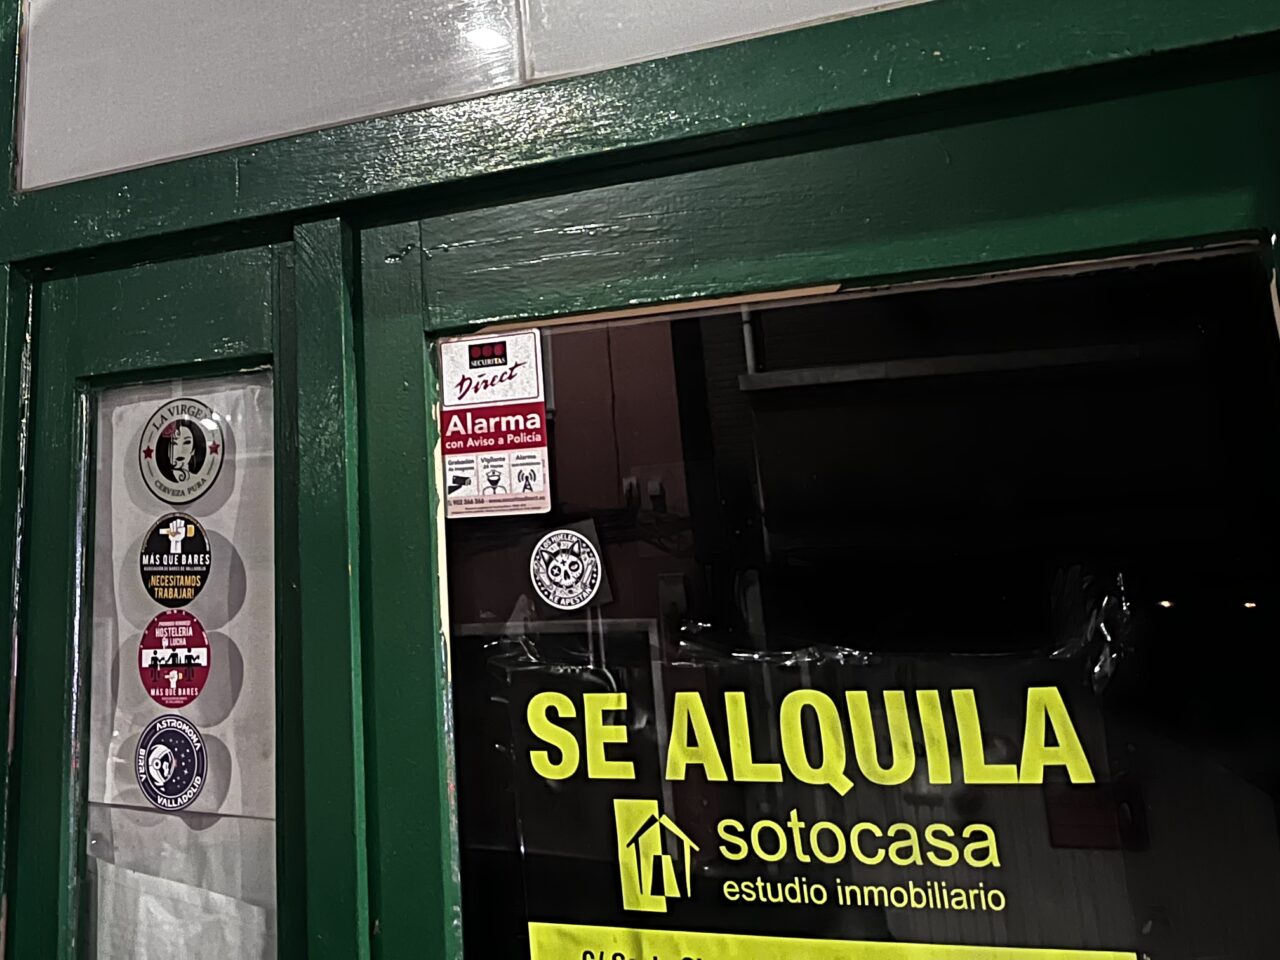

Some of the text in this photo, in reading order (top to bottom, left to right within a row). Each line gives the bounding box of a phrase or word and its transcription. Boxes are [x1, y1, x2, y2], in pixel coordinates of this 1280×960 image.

[470, 357, 506, 367] SECURITAS
[454, 361, 527, 400] Direct
[152, 414, 169, 431] LA
[445, 412, 541, 437] Alarma
[445, 431, 542, 449] con Aviso a Policía
[154, 477, 207, 496] CERVEZA PURA
[162, 554, 179, 565] QUE
[181, 553, 210, 565] BARES
[153, 587, 195, 599] TRABAJAR!
[526, 686, 1096, 797] SE ALQUILA
[157, 775, 202, 807] VALLADOLID
[719, 808, 1001, 868] sotocasa
[723, 876, 1006, 912] estudio inmobiliario
